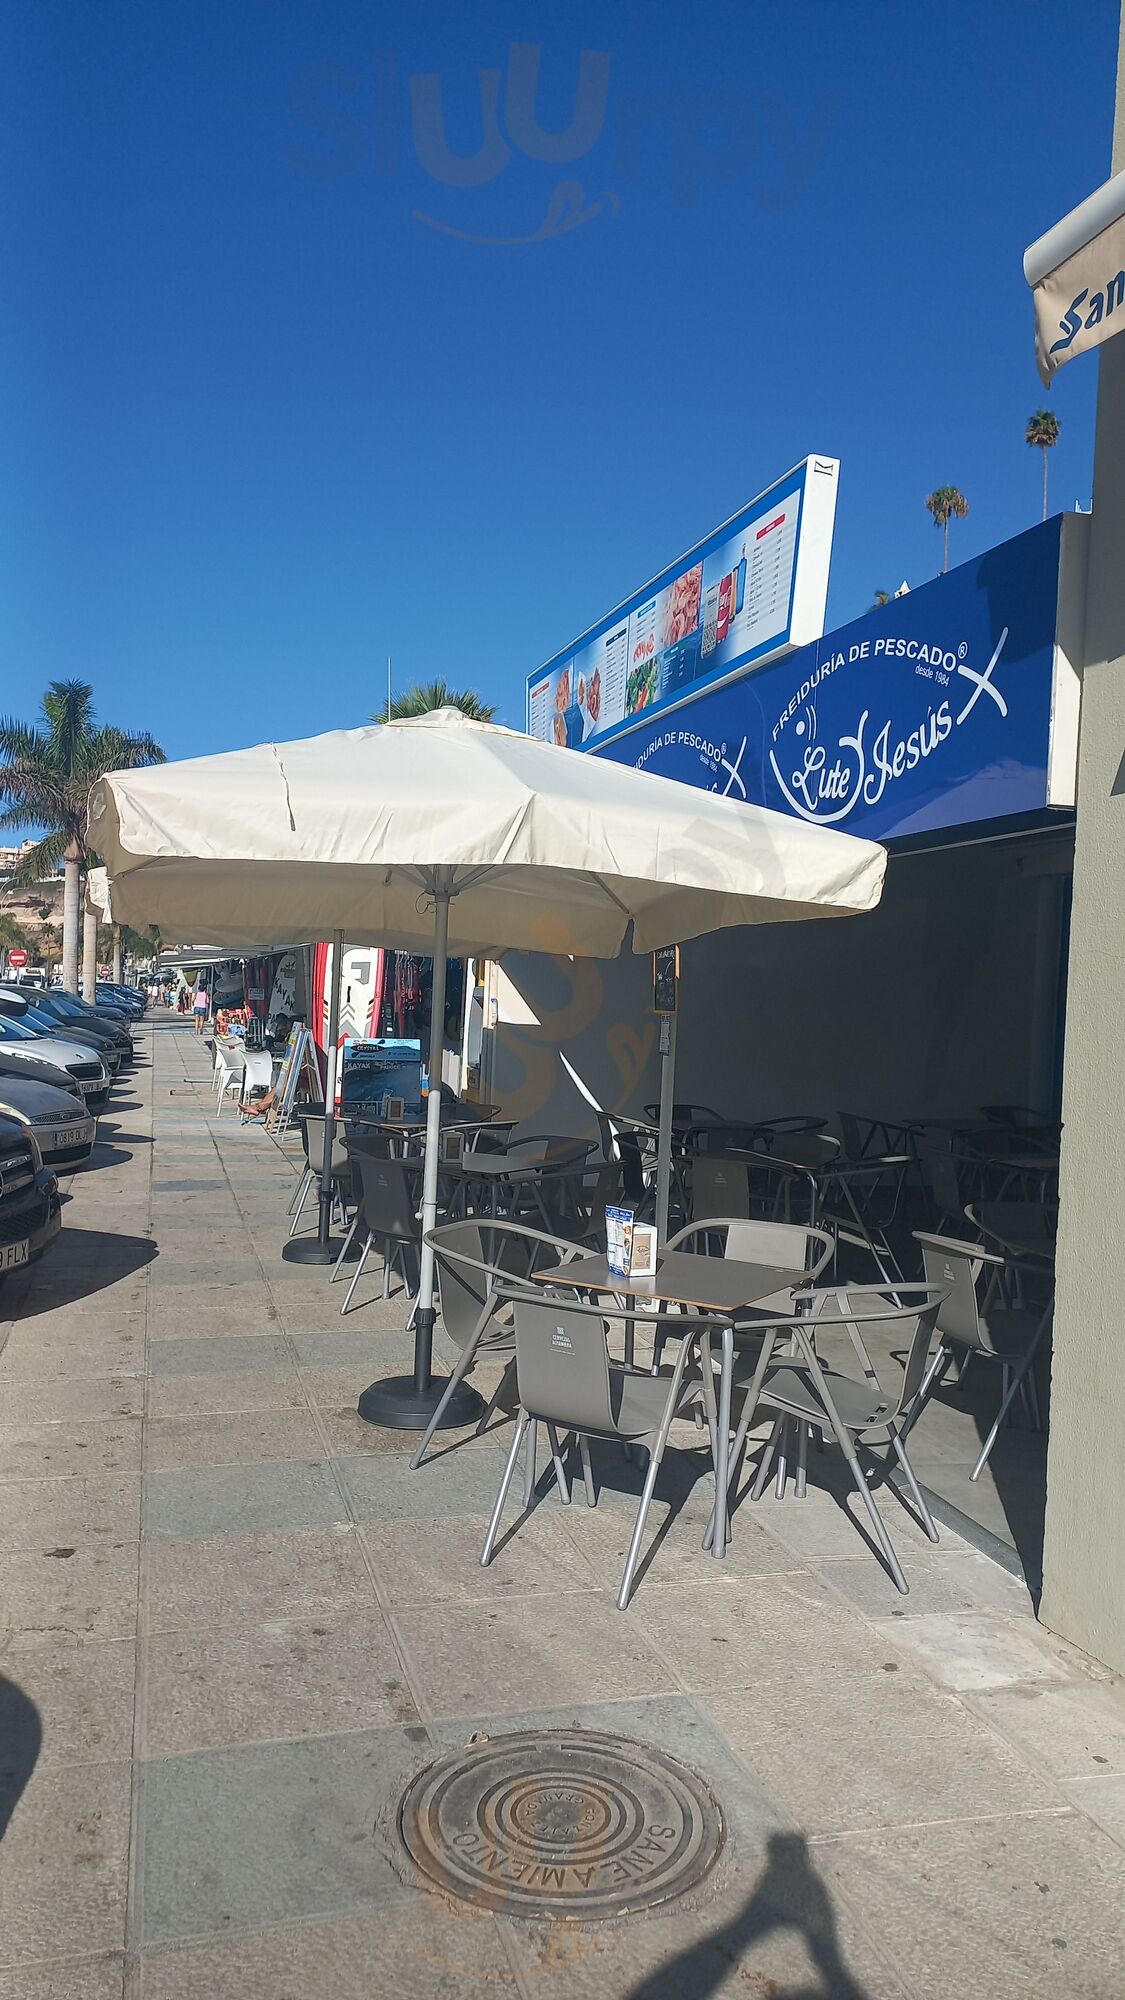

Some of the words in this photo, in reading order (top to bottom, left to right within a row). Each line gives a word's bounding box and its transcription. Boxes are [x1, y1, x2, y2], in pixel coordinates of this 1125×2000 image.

[771, 652, 845, 742] FREIDURÍA
[849, 640, 871, 663] DE
[914, 663, 934, 679] desde
[934, 670, 950, 687] 1984
[664, 731, 677, 745] DE
[791, 745, 851, 811] Lute
[863, 699, 953, 805] Jesús
[7, 1242, 27, 1266] FLX
[452, 1823, 677, 1890] SANEAMIENTO
